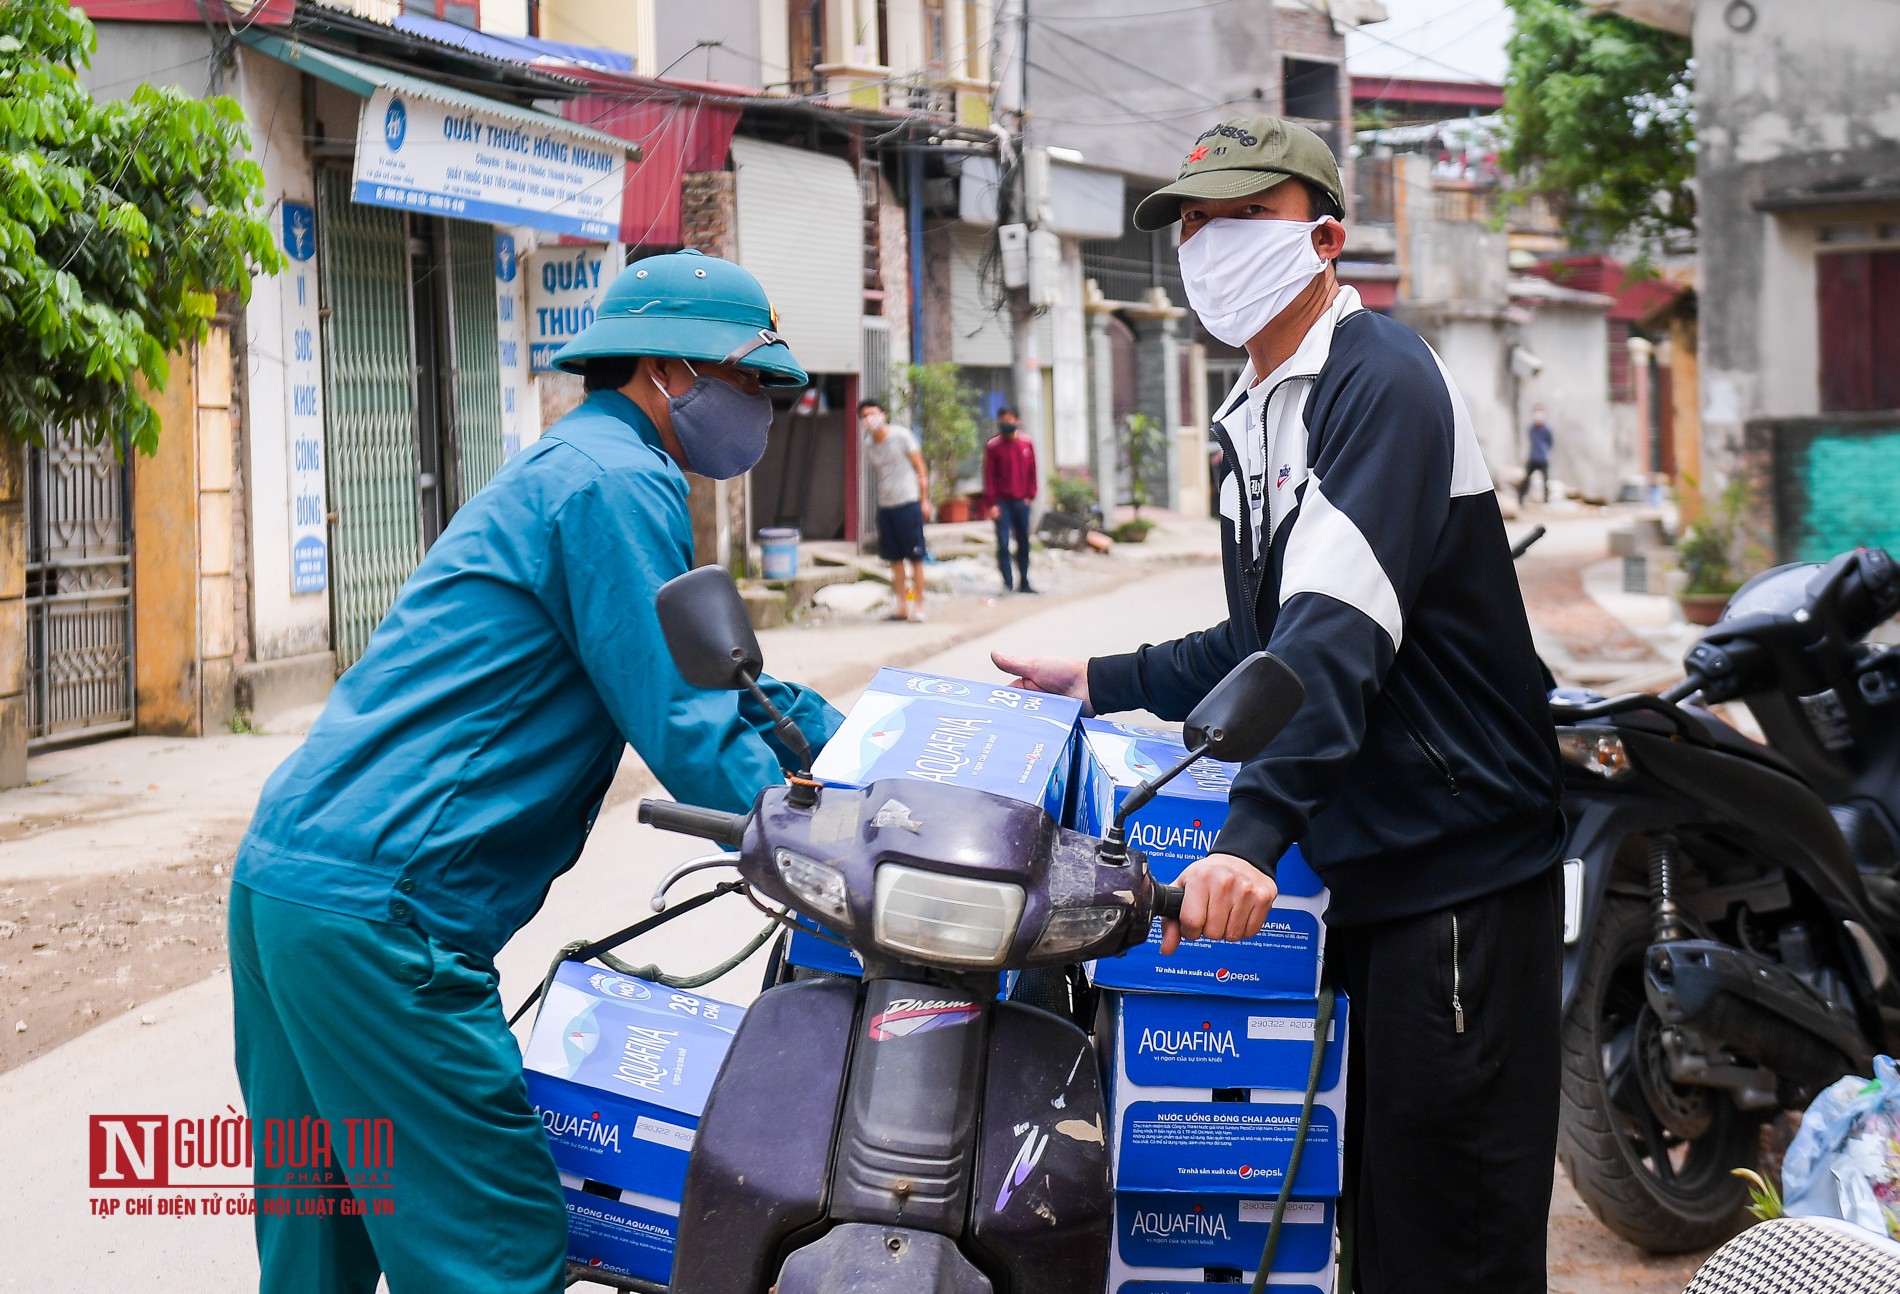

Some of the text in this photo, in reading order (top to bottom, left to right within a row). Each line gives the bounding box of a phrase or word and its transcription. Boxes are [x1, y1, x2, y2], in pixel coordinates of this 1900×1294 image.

[571, 146, 614, 173] NHANH
[536, 294, 596, 336] THUỐ
[987, 689, 1022, 708] 28
[1022, 695, 1044, 711] CHAI
[905, 716, 993, 786] AQUAFINA
[1230, 972, 1257, 982] pepsi
[668, 993, 700, 1016] 28
[702, 1002, 720, 1020] CHAI
[884, 998, 973, 1015] Dream
[1251, 1020, 1285, 1028] 290322
[1138, 1027, 1236, 1058] AQUAFINA
[612, 1024, 679, 1094] AQUAFINA
[1157, 1113, 1183, 1121] NƯỚC
[1185, 1112, 1211, 1122] UỐNG
[1213, 1114, 1239, 1123] ĐÓNG
[636, 1121, 670, 1136] 290322
[1253, 1168, 1280, 1177] pepsi
[1242, 1202, 1276, 1210] 290322
[576, 1206, 603, 1218] ĐÓNG
[603, 1213, 625, 1224] CHAI
[625, 1219, 670, 1236] AQUAFINA
[1130, 1210, 1228, 1240] AQUAFINA
